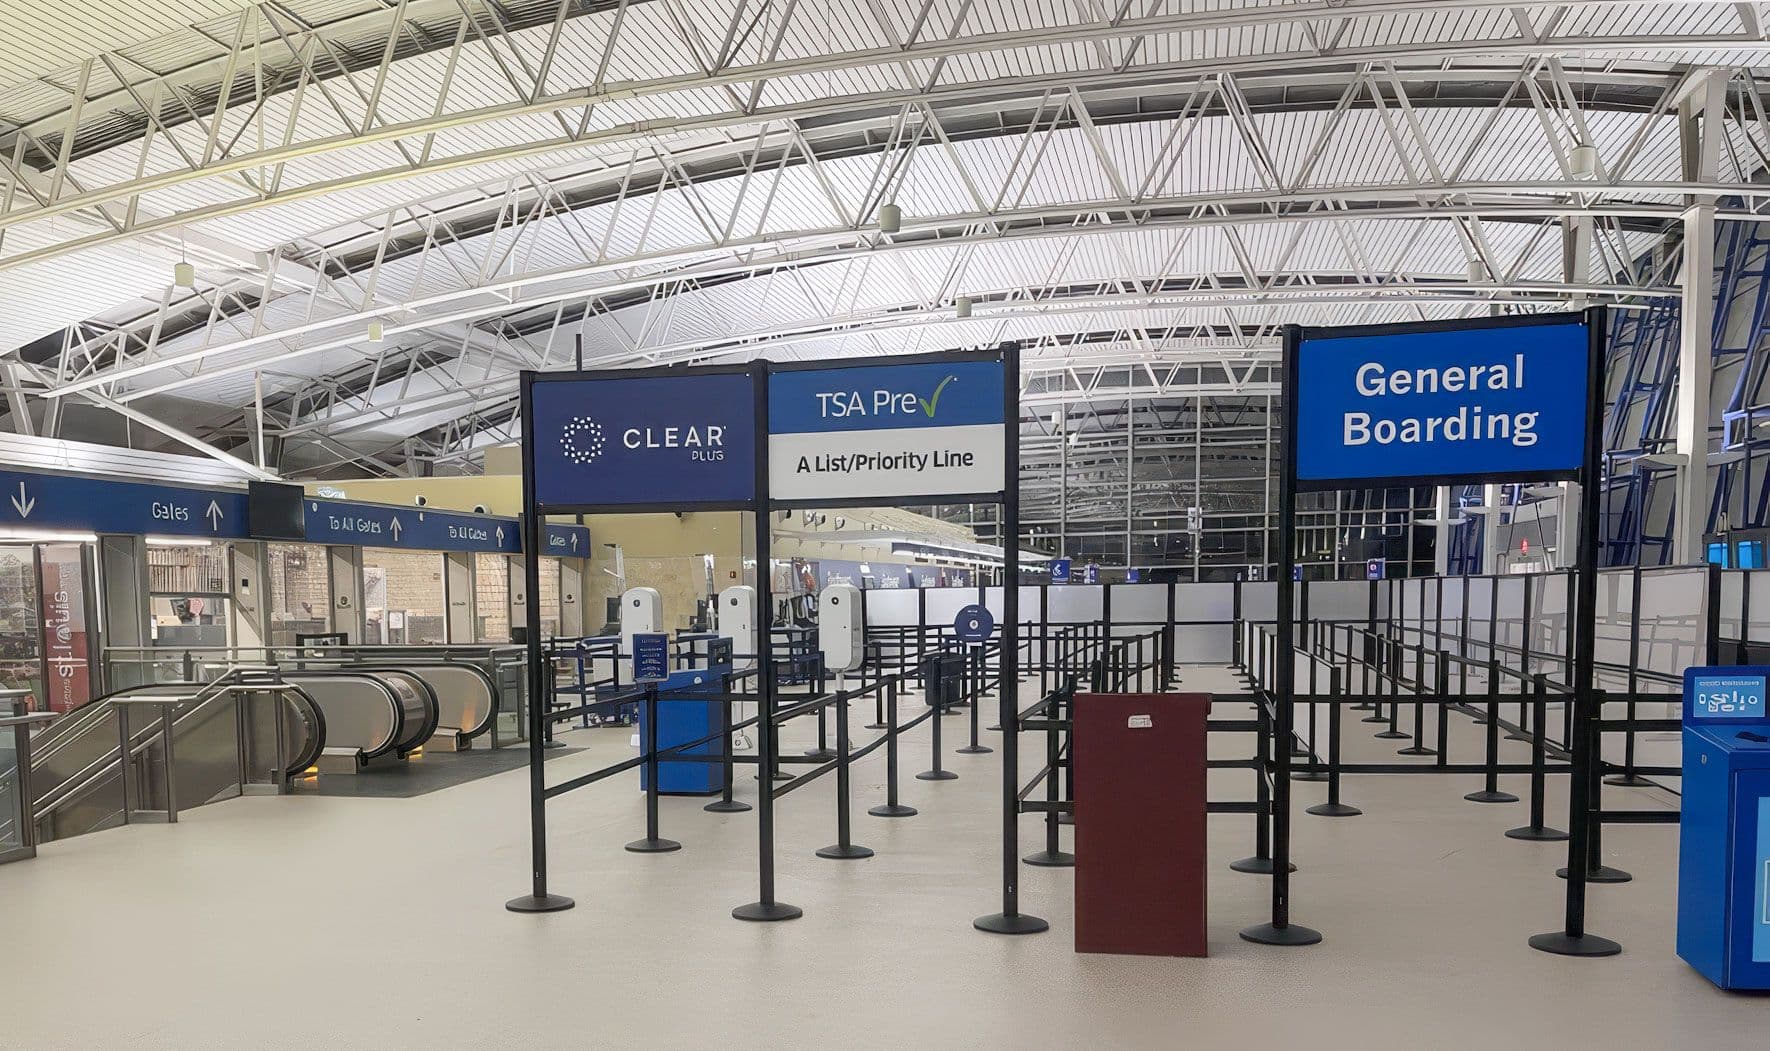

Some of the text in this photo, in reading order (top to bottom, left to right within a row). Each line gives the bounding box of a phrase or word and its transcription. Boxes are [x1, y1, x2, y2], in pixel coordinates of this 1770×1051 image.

[1355, 353, 1524, 397] General
[815, 391, 866, 418] TSA
[623, 425, 724, 449] CLEAR
[1343, 405, 1540, 447] Boarding
[796, 449, 974, 474] A List/Priority Line
